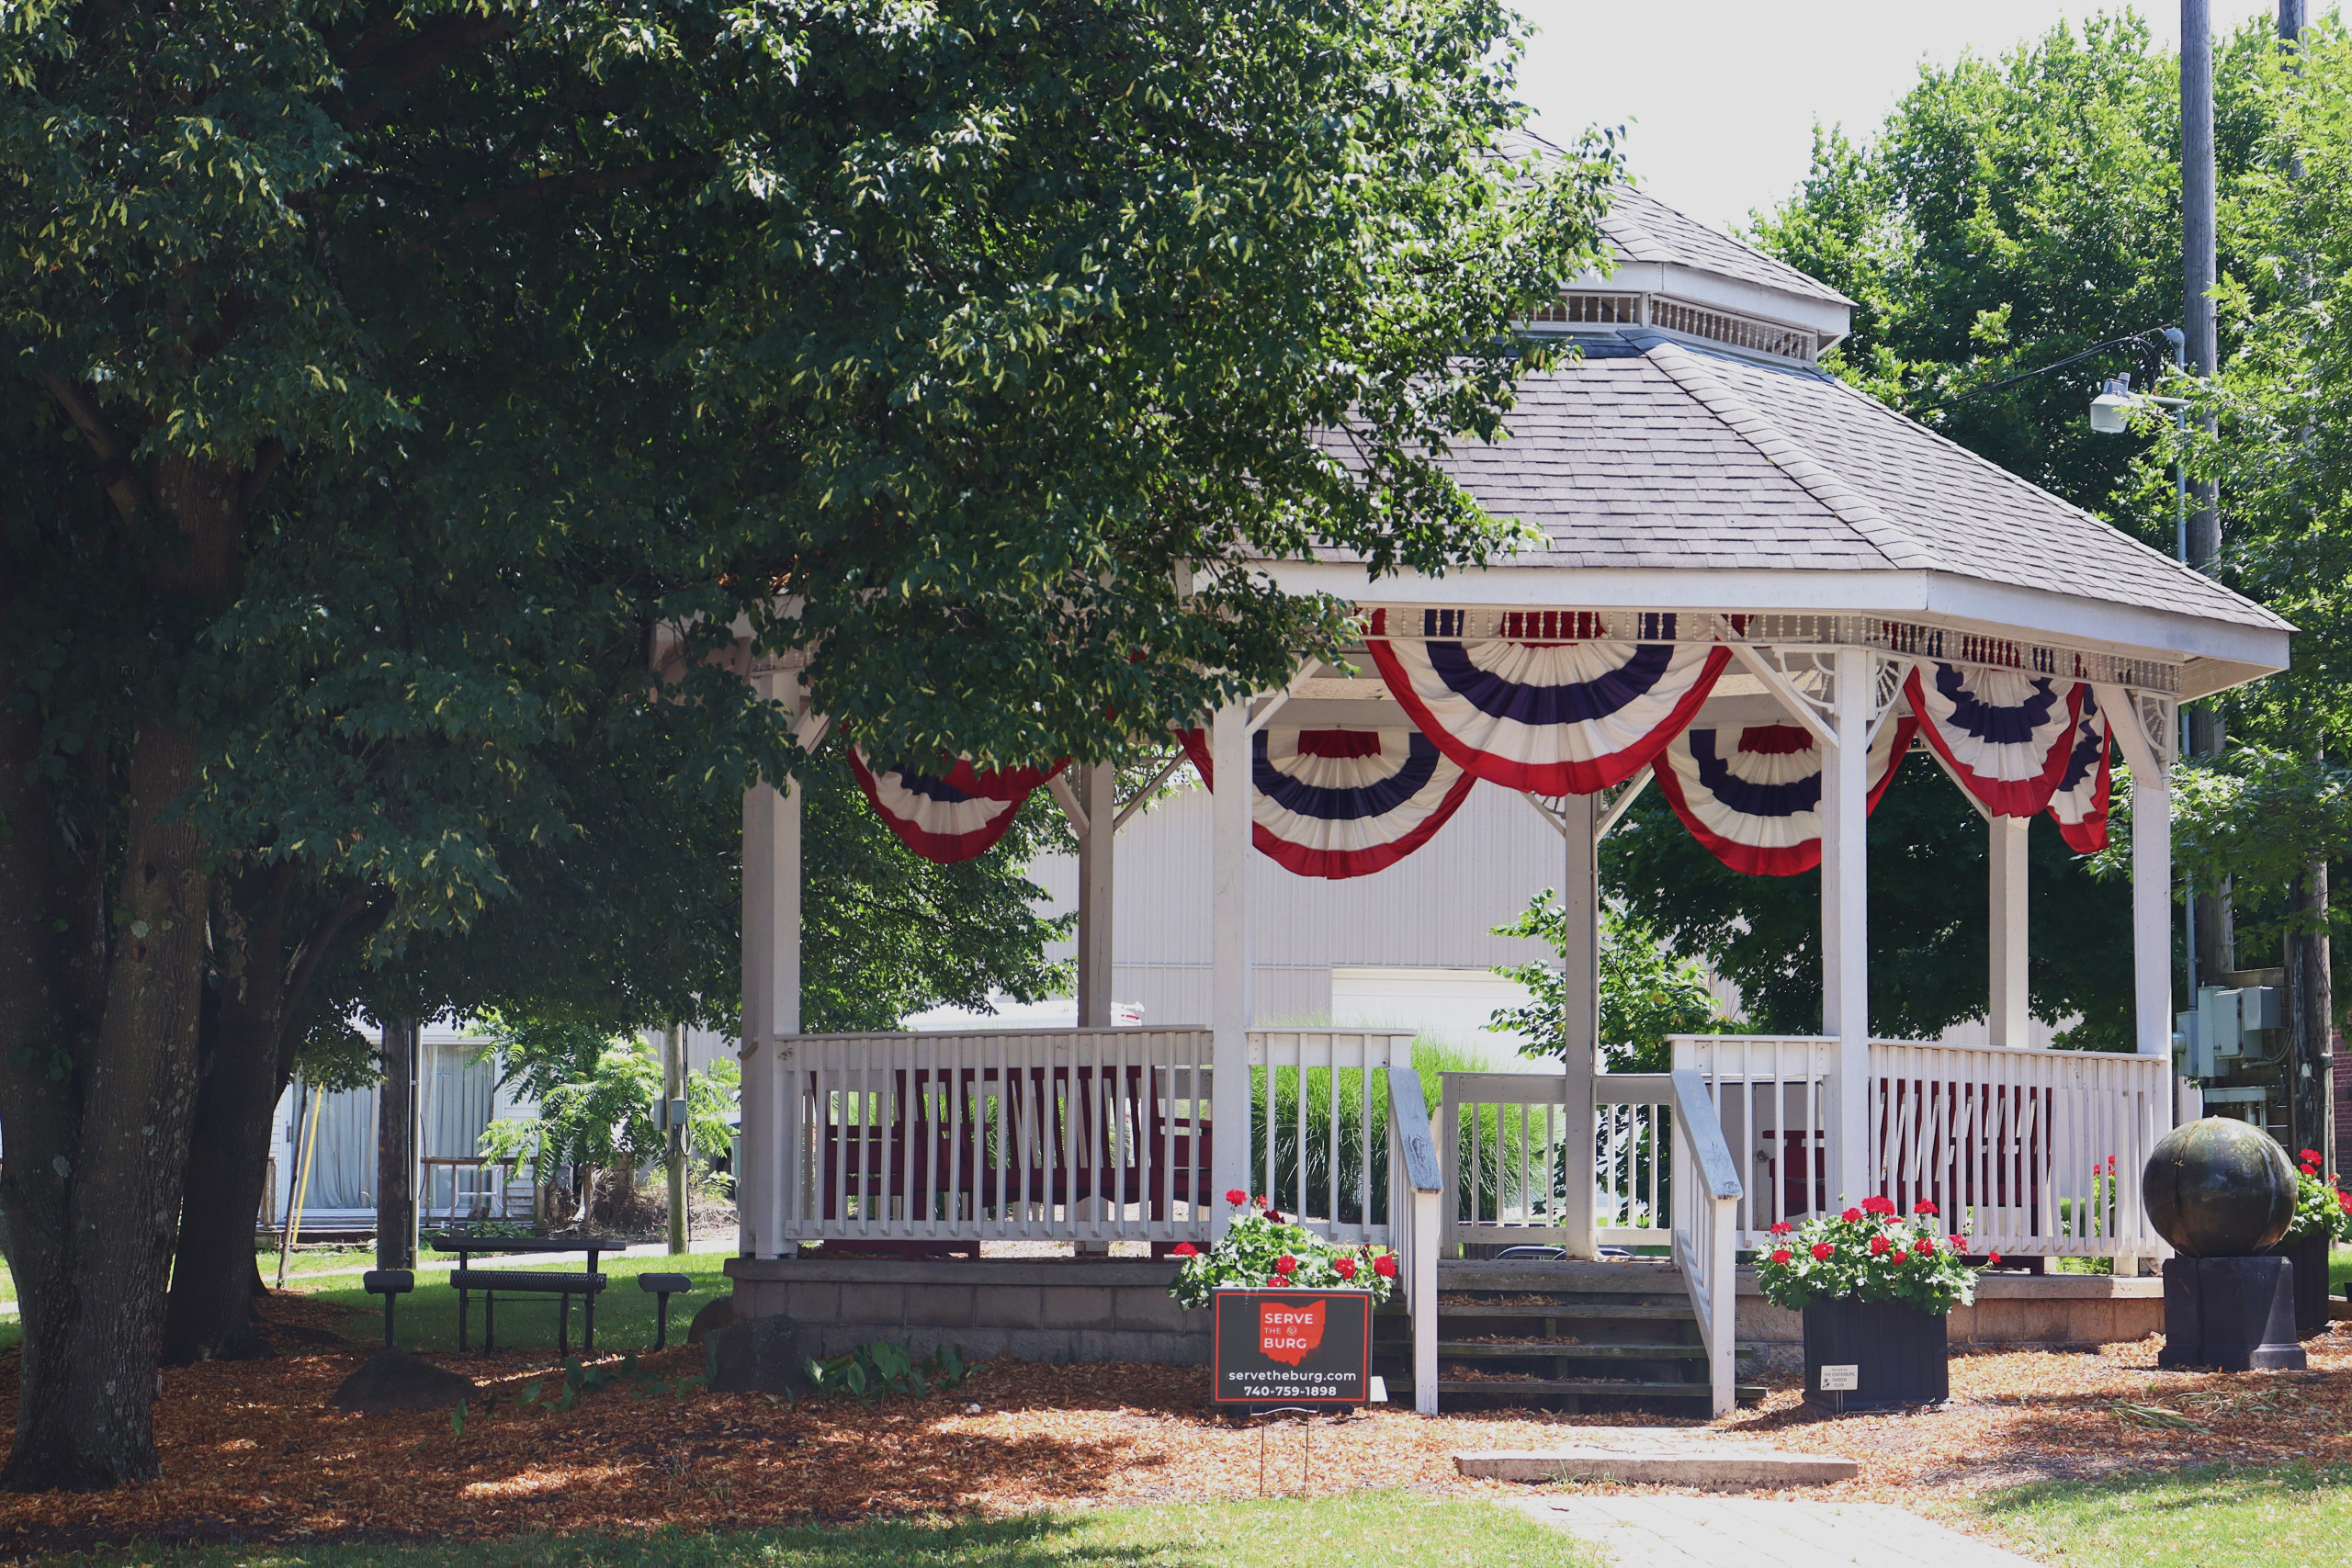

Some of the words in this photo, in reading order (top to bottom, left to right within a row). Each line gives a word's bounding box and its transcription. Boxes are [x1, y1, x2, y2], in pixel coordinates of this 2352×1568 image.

[1264, 1313, 1314, 1325] SERVE
[1264, 1338, 1306, 1348] BURG
[1228, 1370, 1356, 1383] servetheburg.com
[1244, 1386, 1337, 1396] 740-759-1898
